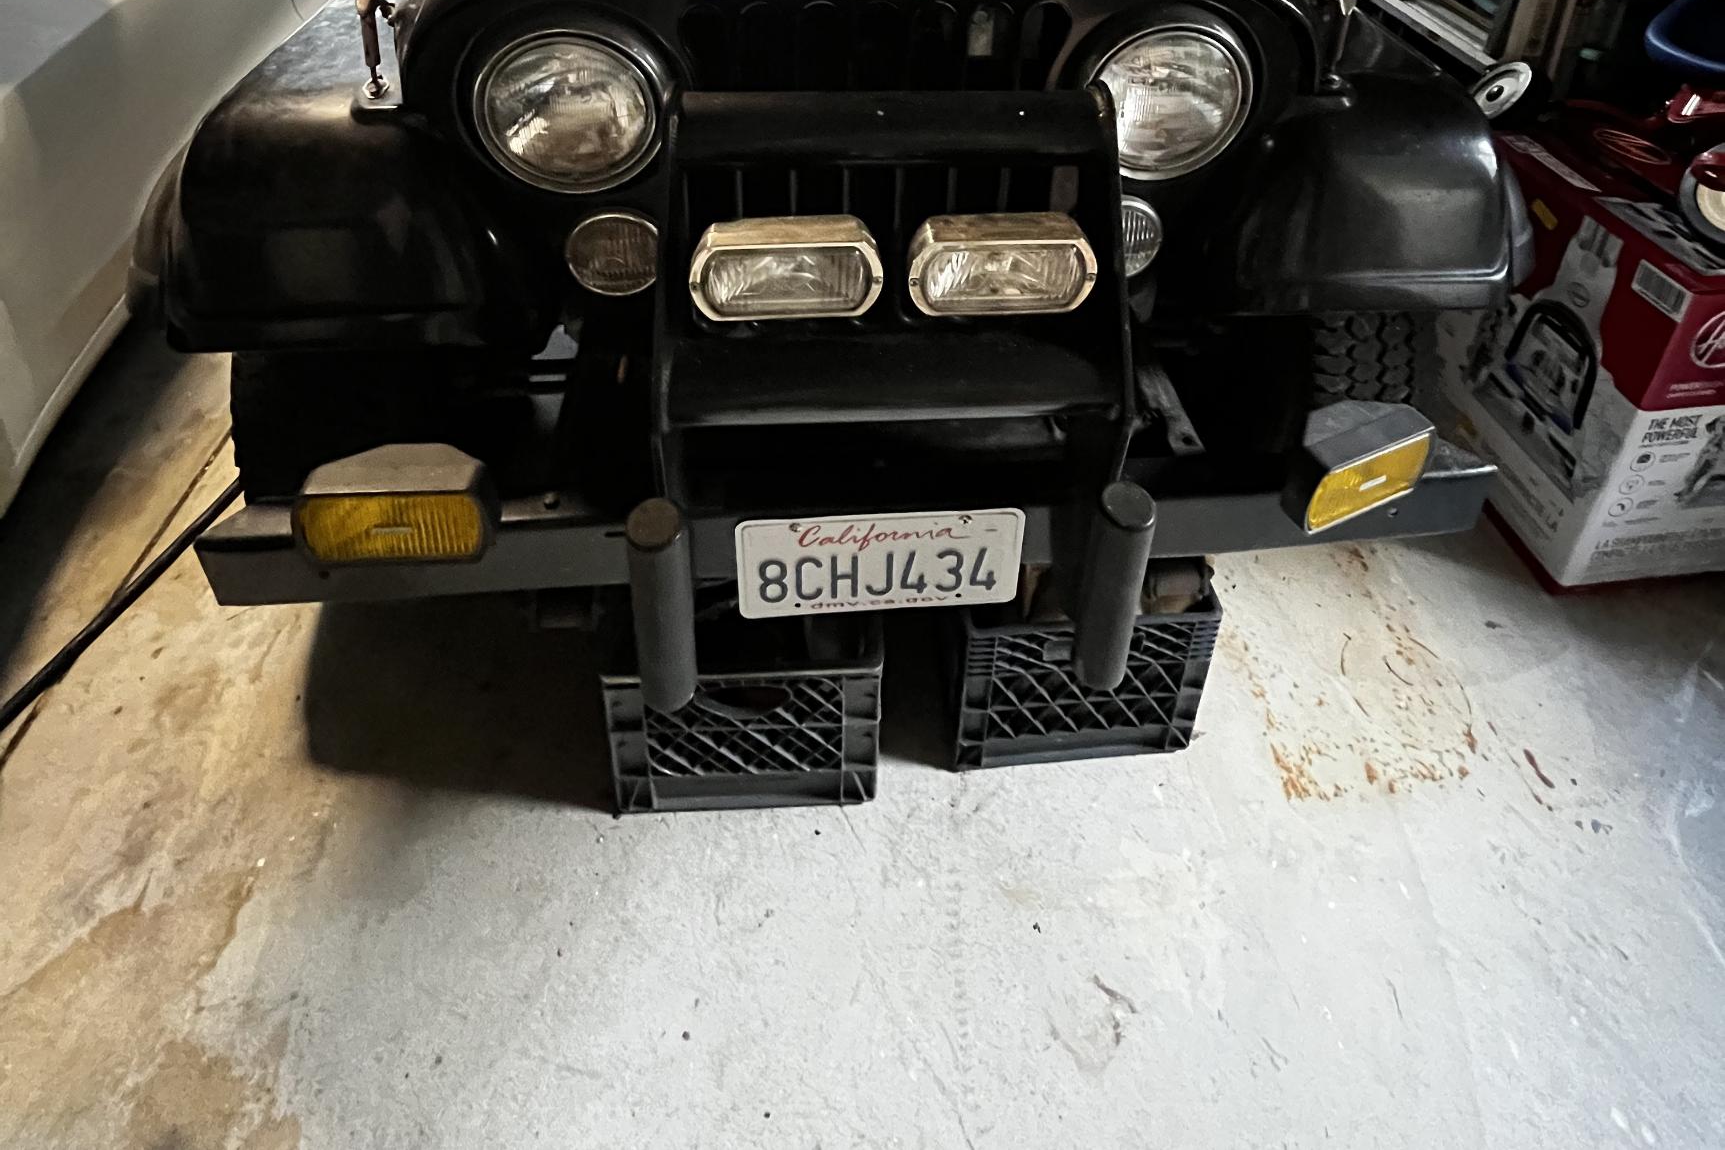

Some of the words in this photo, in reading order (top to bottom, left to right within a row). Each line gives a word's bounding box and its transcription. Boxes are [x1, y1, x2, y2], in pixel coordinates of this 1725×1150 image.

[1648, 417, 1669, 431] THE
[1669, 414, 1703, 429] MOST
[1641, 427, 1698, 443] POWERFUL
[798, 523, 970, 551] California
[758, 547, 997, 603] 8CHJ434
[810, 594, 949, 610] dmv.ca.gov
